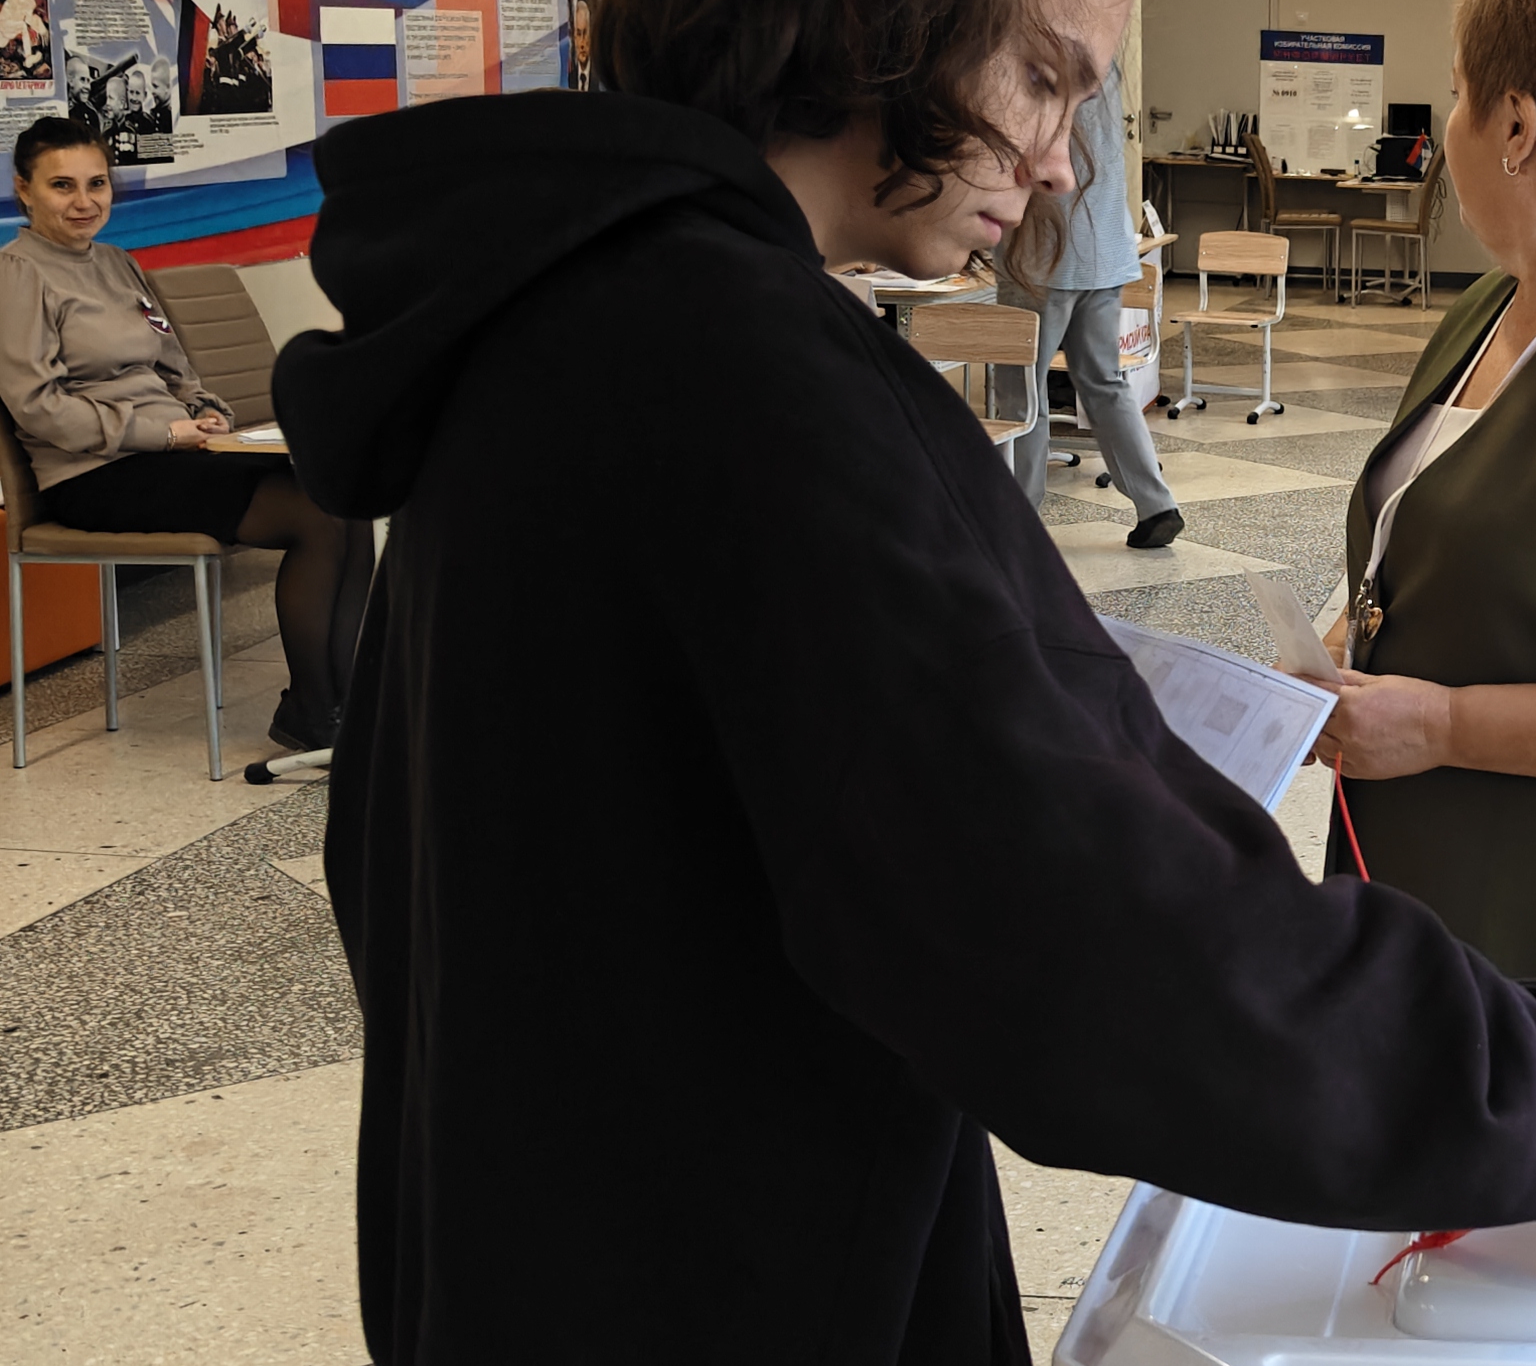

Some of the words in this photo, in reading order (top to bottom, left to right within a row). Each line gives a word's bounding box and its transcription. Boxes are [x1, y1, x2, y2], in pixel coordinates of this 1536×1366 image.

[1300, 35, 1345, 43] УЧАСТКОВАЯ
[1274, 41, 1333, 50] ИЗБИРАТЕЛЬНАЯ
[1333, 43, 1371, 51] КОМИССИЯ
